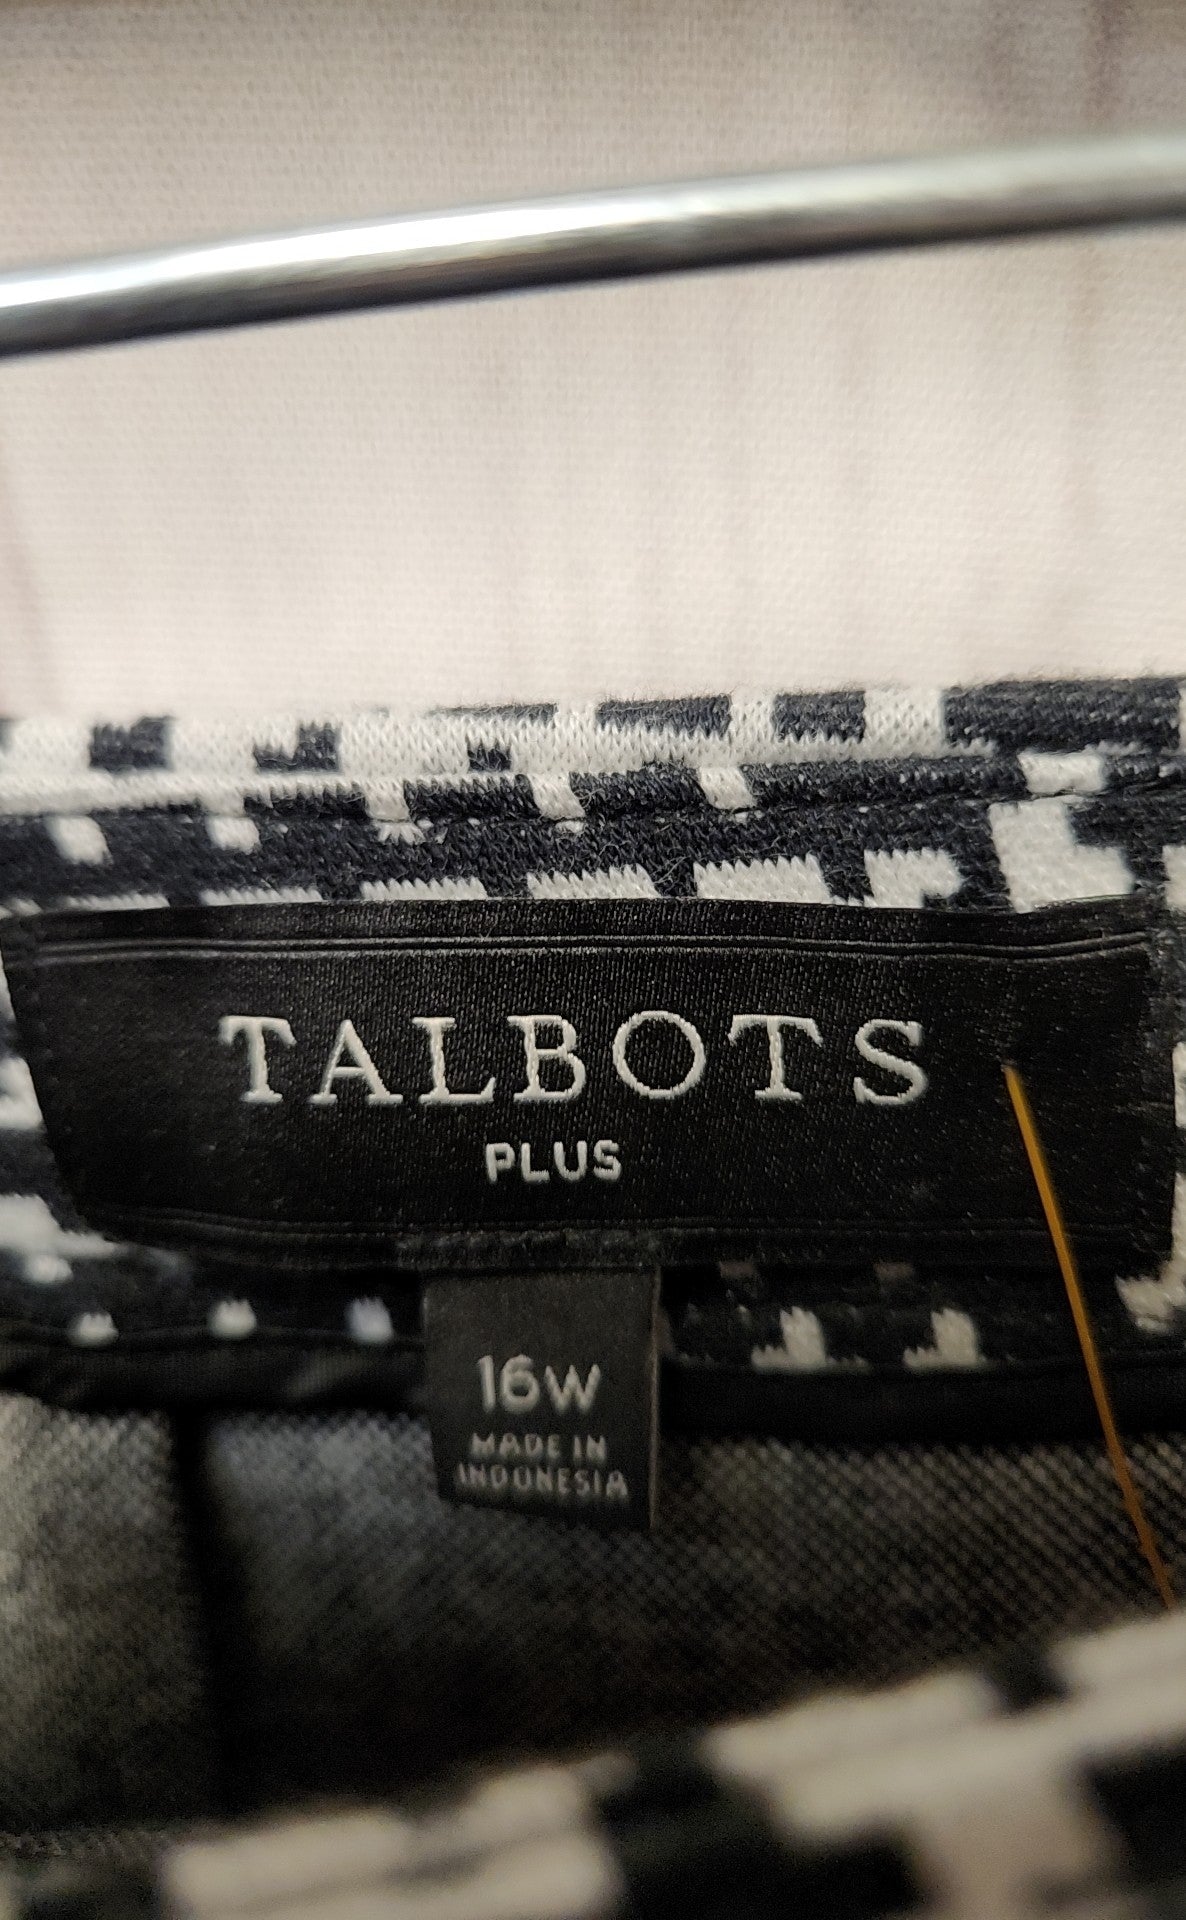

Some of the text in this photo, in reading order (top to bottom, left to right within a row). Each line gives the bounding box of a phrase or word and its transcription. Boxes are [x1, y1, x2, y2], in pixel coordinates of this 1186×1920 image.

[218, 1010, 929, 1105] TALBOTS
[484, 1139, 622, 1183] PLUS
[478, 1354, 601, 1415] 16W
[470, 1432, 607, 1464] MADE IN
[456, 1462, 630, 1501] INDONESIA
